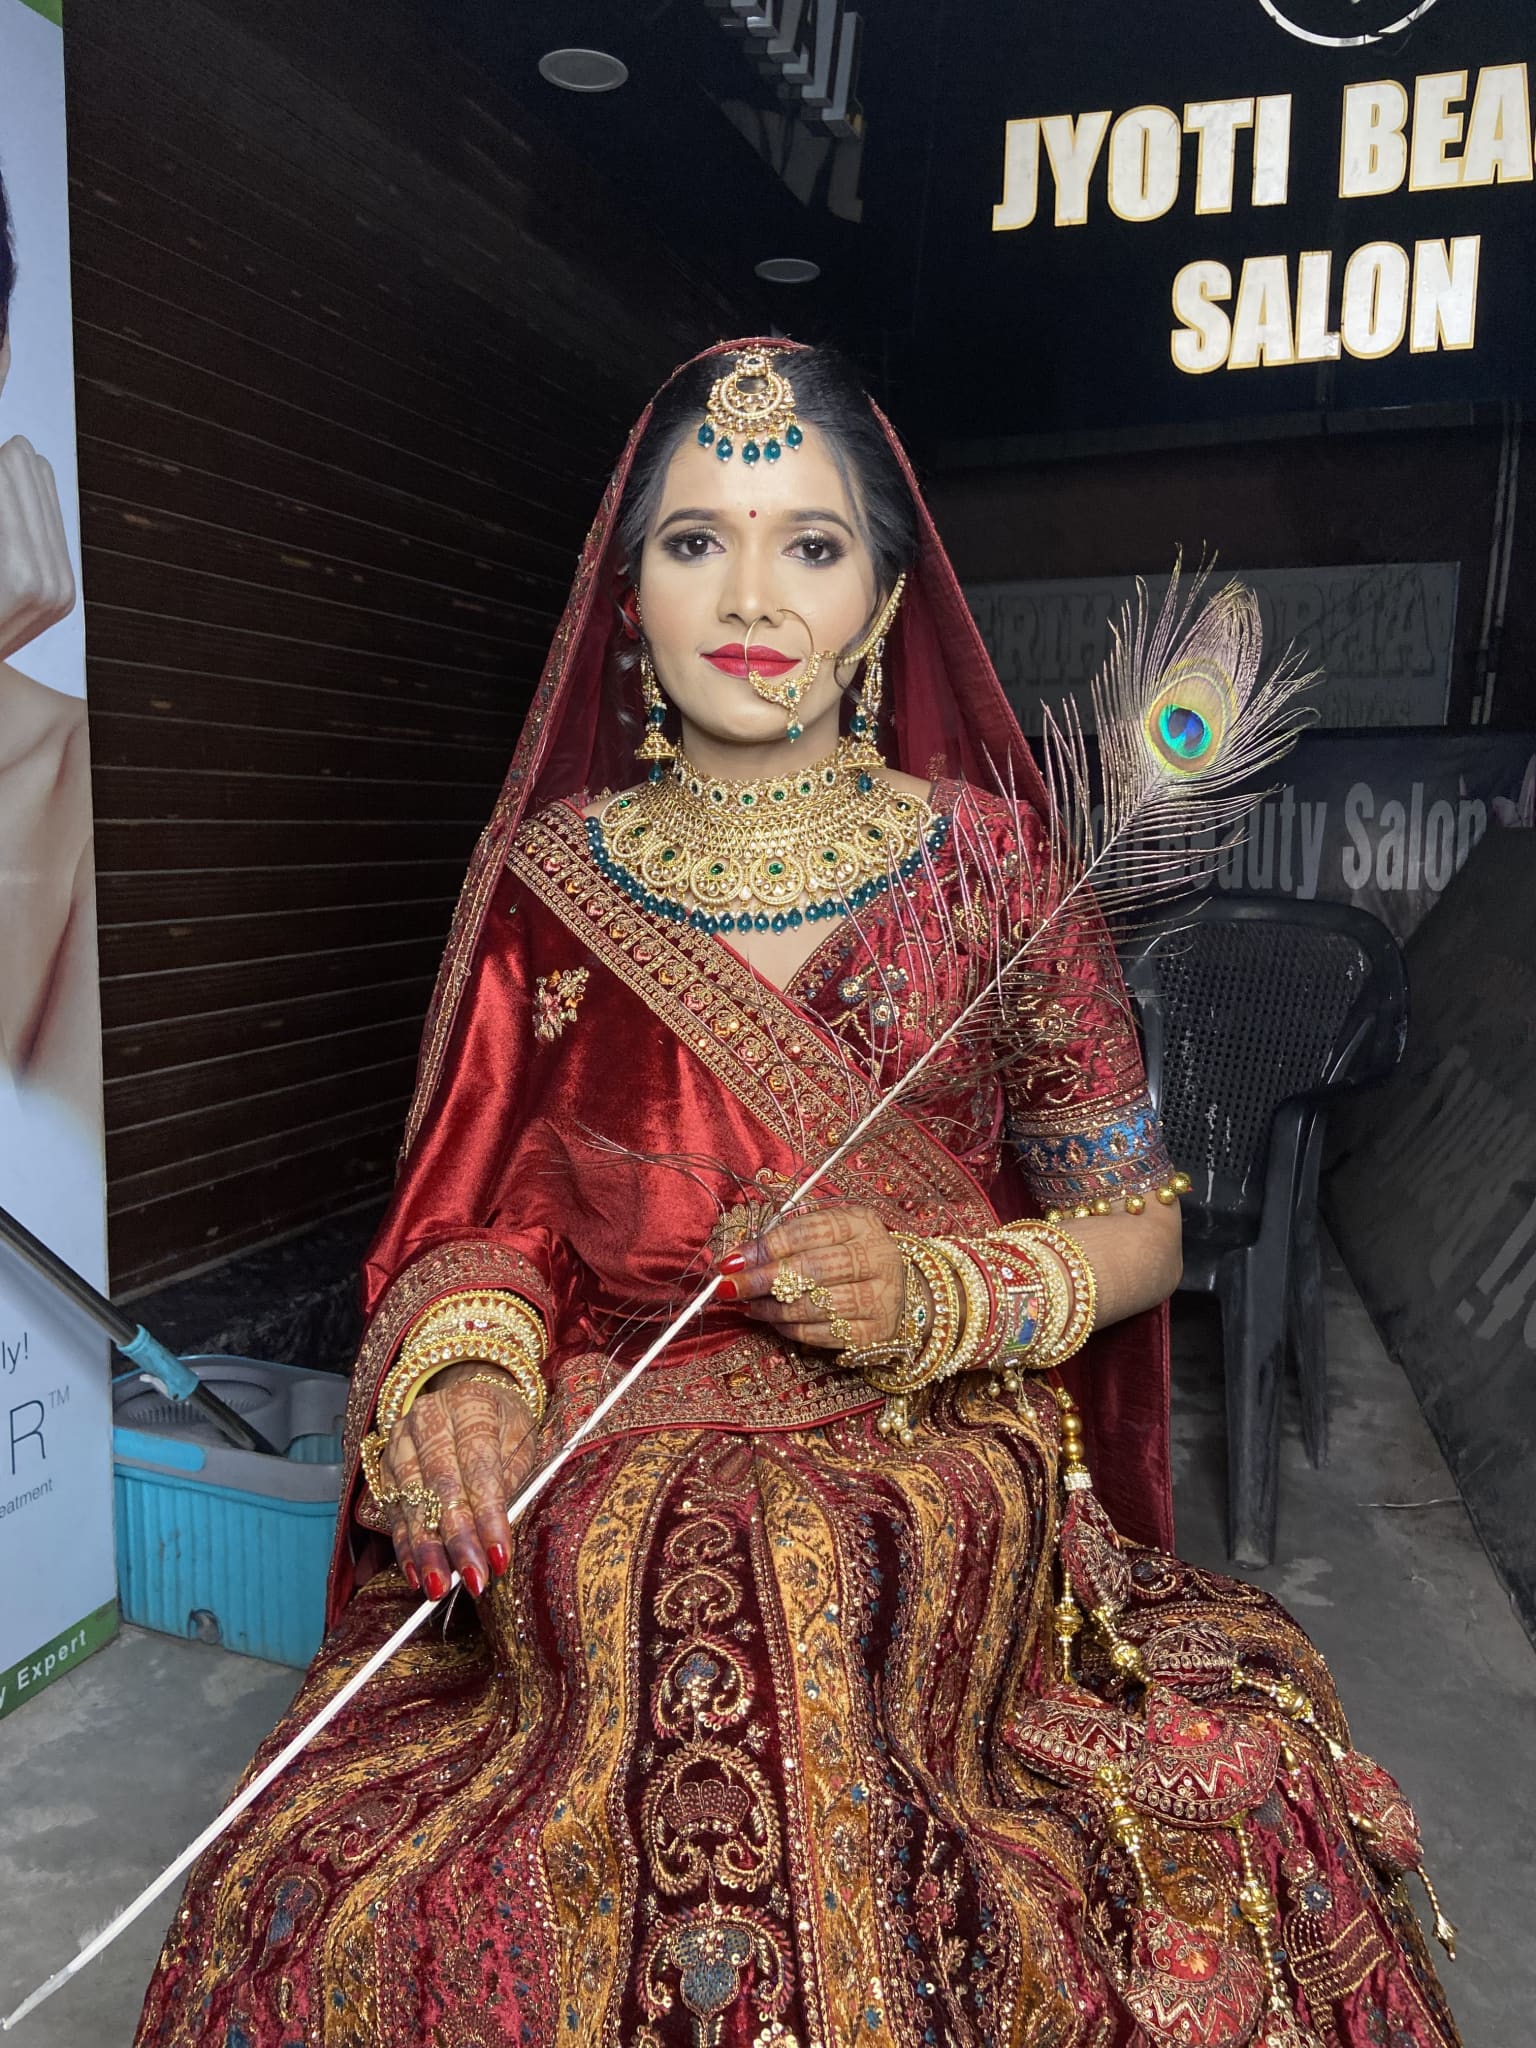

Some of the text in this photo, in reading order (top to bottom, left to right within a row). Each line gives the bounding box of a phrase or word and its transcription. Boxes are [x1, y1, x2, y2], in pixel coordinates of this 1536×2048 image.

[992, 93, 1292, 231] JYOTI
[1338, 62, 1536, 199] BEA
[1171, 235, 1480, 375] SALON
[1342, 782, 1488, 892] Salon
[17, 1629, 86, 1690] Expert
